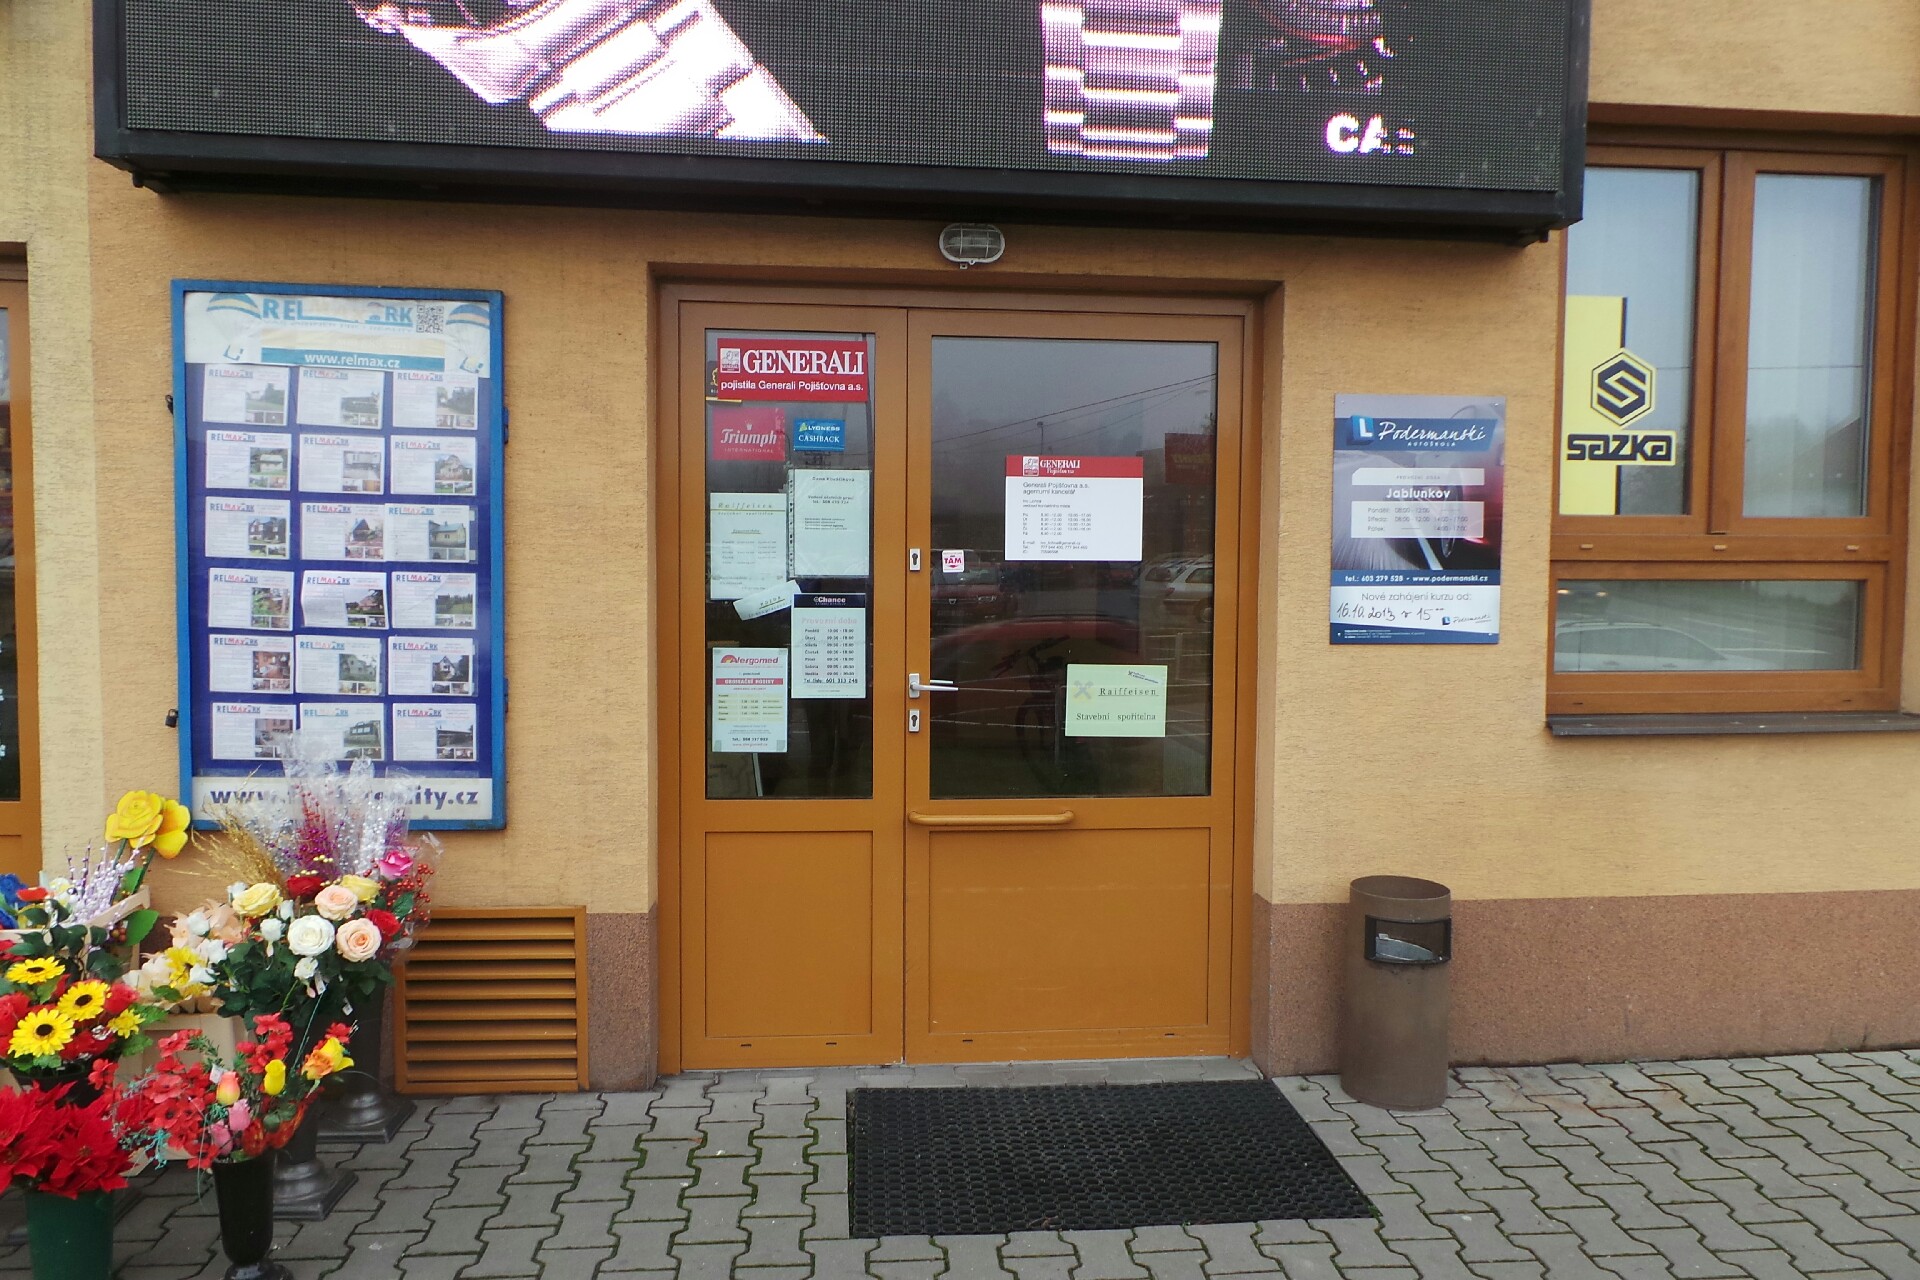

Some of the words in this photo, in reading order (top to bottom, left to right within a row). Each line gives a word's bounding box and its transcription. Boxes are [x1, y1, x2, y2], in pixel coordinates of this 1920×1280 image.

[304, 353, 400, 368] www.relmax.cz
[743, 350, 864, 375] GENERALI
[721, 381, 756, 391] pojistila
[759, 381, 796, 390] Generali
[799, 381, 845, 392] Pojišťovna
[1378, 421, 1486, 441] Podermanski
[721, 428, 777, 448] Triumph
[799, 434, 840, 443] CASHBACK
[1040, 460, 1080, 469] GENERALI
[1386, 488, 1451, 499] Jablunkov
[1412, 575, 1488, 583] www.podermanski.cz
[1361, 592, 1386, 601] Nové
[1389, 592, 1429, 603] zahájení
[1430, 592, 1453, 601] kurzu
[1456, 592, 1472, 601] od:
[1100, 687, 1156, 695] Raiffeisen
